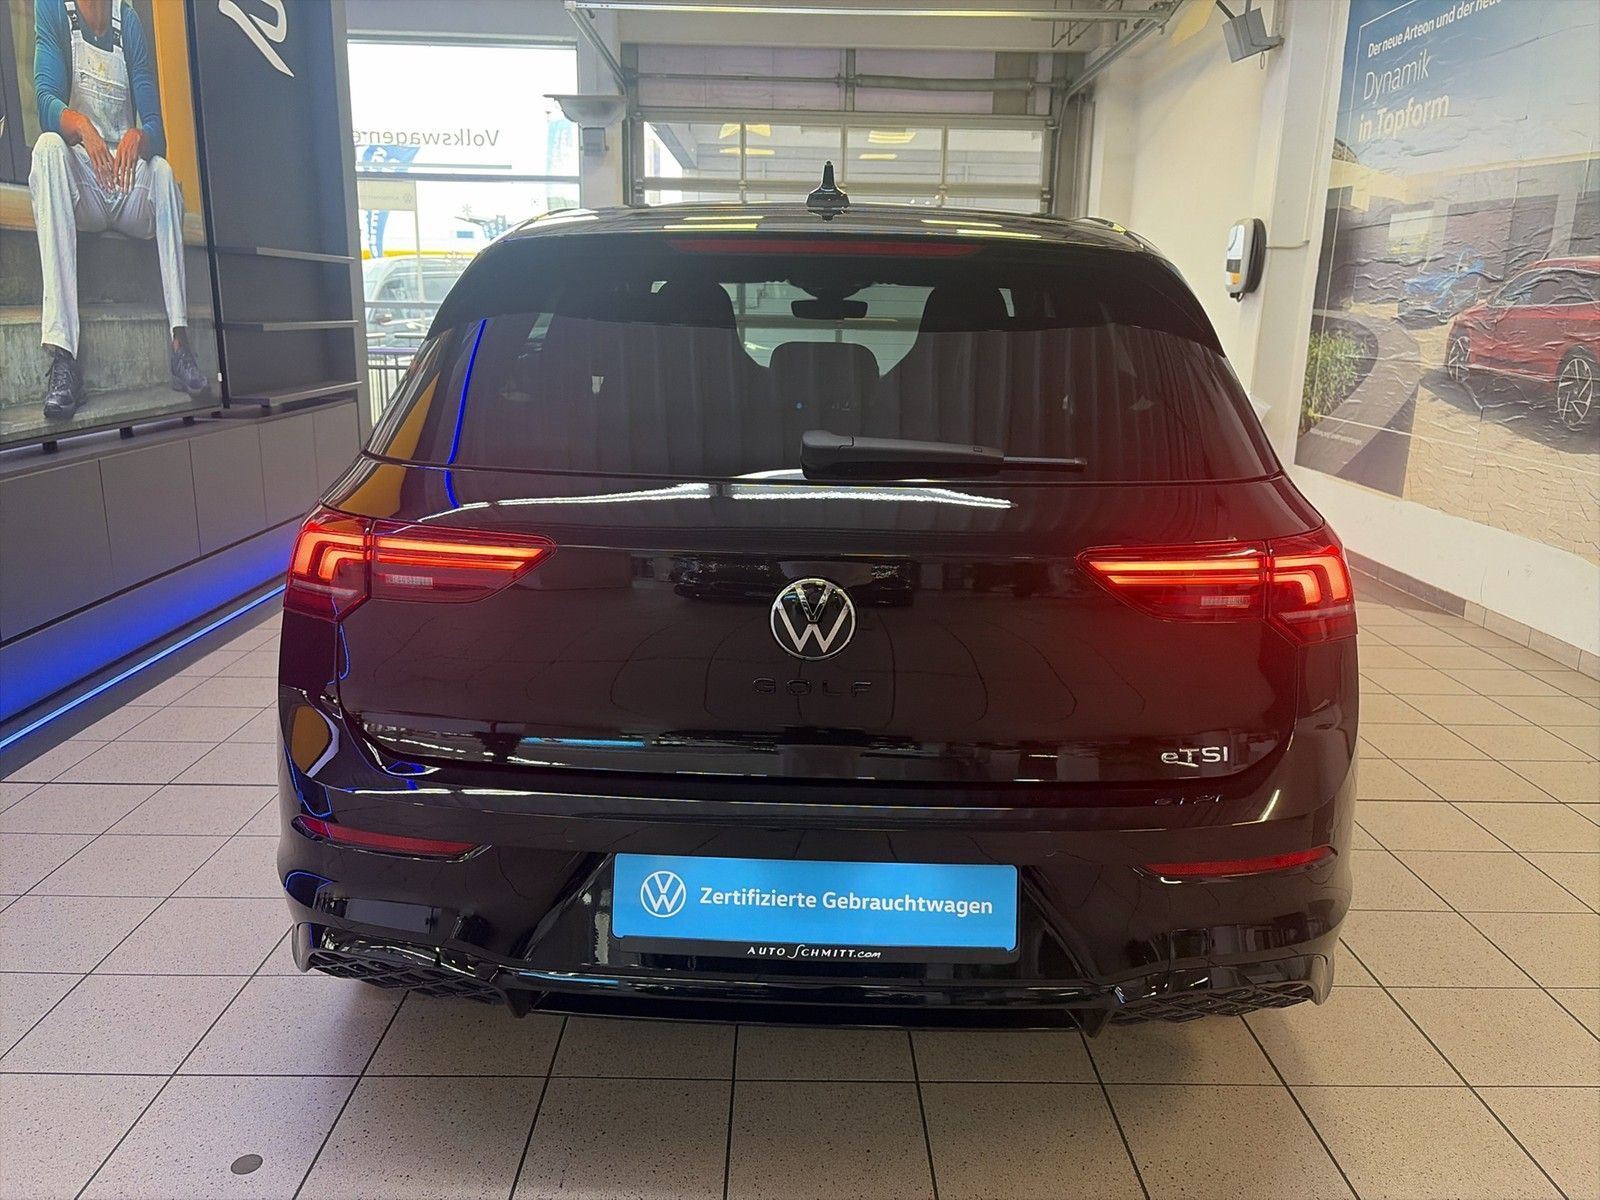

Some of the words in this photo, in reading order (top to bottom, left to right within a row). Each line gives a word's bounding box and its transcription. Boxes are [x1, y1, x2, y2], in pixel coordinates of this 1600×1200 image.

[1367, 41, 1383, 58] Der
[1382, 32, 1403, 51] neue
[1403, 18, 1435, 43] Arteon
[1436, 6, 1456, 28] und
[1457, 0, 1475, 20] der
[1363, 48, 1433, 104] Dynamik
[1358, 113, 1372, 142] in
[1376, 95, 1450, 140] Topform
[753, 677, 872, 696] GOLF
[1161, 746, 1229, 767] eTSI
[700, 887, 817, 908] Zertifizierte
[822, 891, 993, 917] Gebrauchtwagen
[747, 945, 786, 956] AUTO
